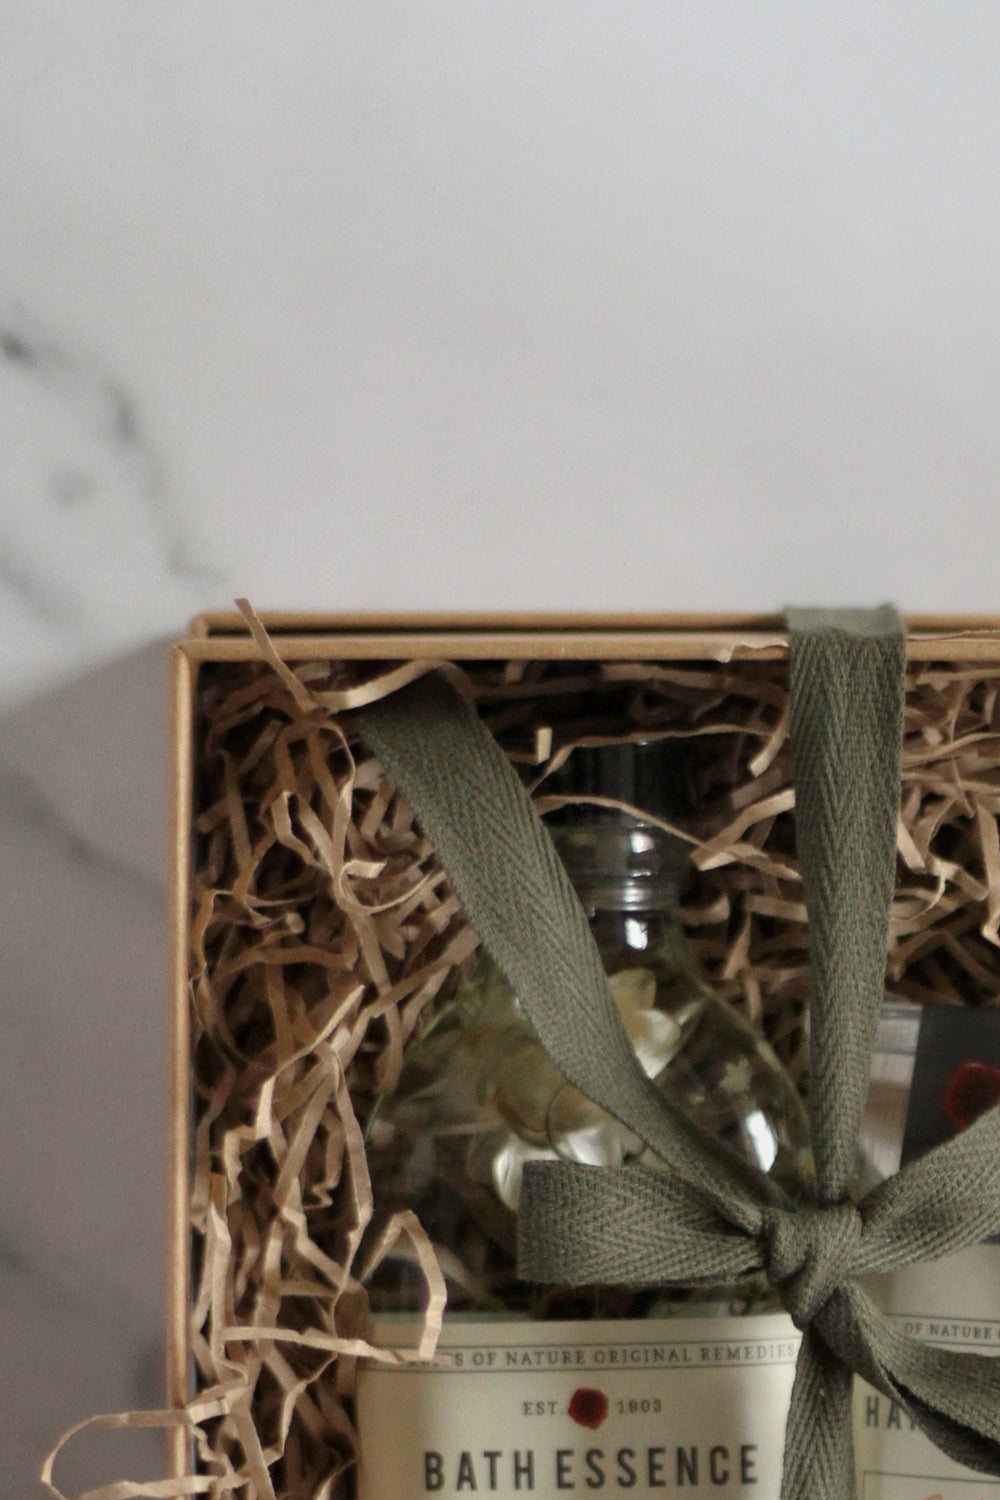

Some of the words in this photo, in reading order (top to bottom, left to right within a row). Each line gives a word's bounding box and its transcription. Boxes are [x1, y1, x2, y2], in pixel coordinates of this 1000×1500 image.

[904, 1322, 923, 1334] OF
[929, 1323, 992, 1340] NATURE
[473, 1352, 498, 1367] OF
[506, 1349, 586, 1366] NATURE
[594, 1347, 693, 1363] ORIGINAL
[701, 1343, 796, 1361] REMEDIES
[424, 1450, 536, 1493] BATH
[556, 1443, 760, 1490] ESSENCE
